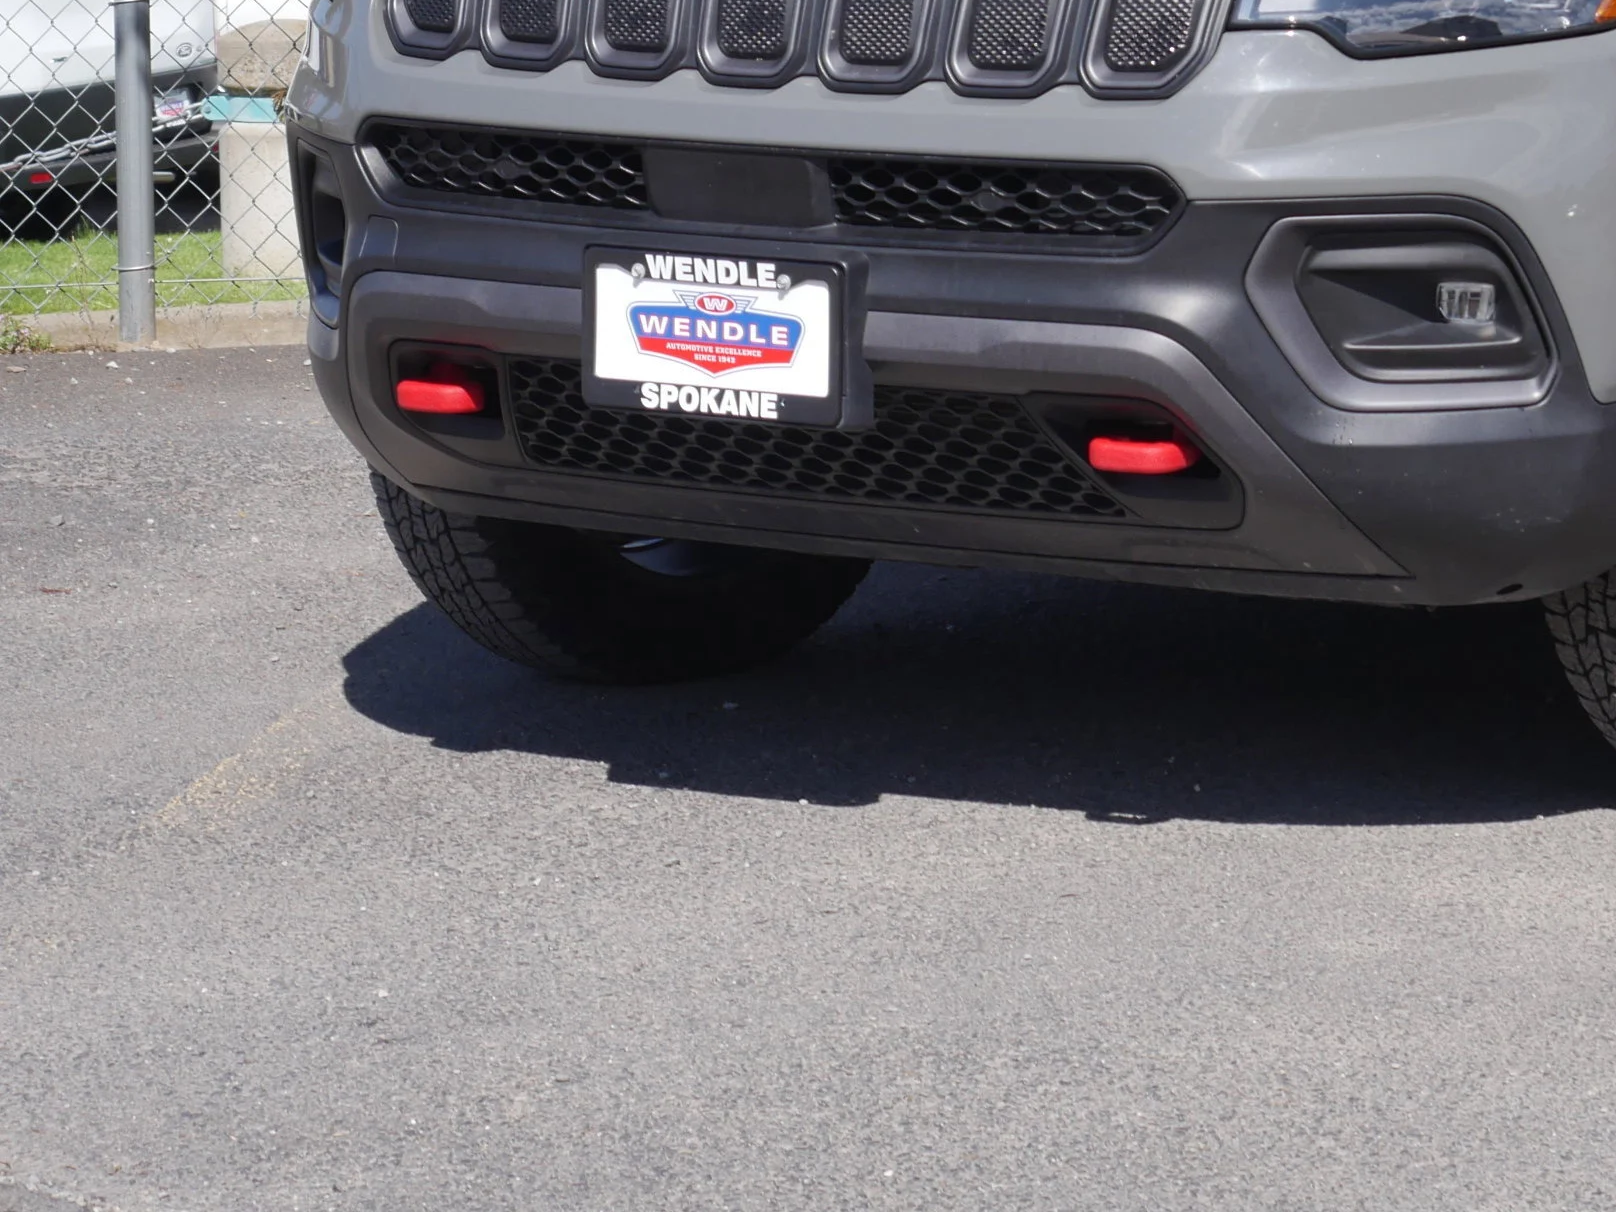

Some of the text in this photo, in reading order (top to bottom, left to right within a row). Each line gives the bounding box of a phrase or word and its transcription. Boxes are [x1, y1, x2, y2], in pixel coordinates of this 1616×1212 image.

[645, 254, 777, 288] WENDLE
[638, 314, 789, 346] WENDLE
[666, 342, 762, 358] AUTOMOTIVE EXCELLENCE
[694, 353, 717, 362] SINCE
[640, 383, 778, 420] SPOKANE
